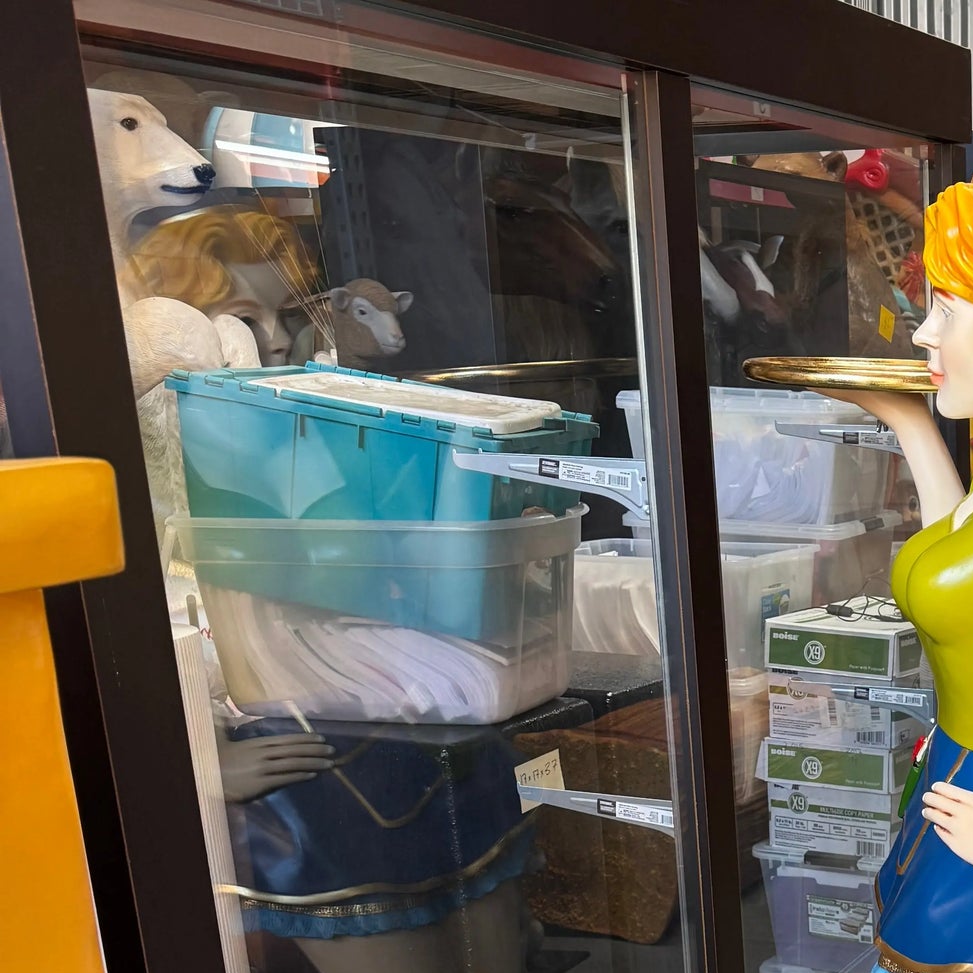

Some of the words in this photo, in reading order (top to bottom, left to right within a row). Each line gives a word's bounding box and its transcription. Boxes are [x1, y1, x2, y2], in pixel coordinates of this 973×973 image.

[807, 645, 821, 661] X9
[805, 760, 818, 775] X9
[791, 795, 805, 811] X9
